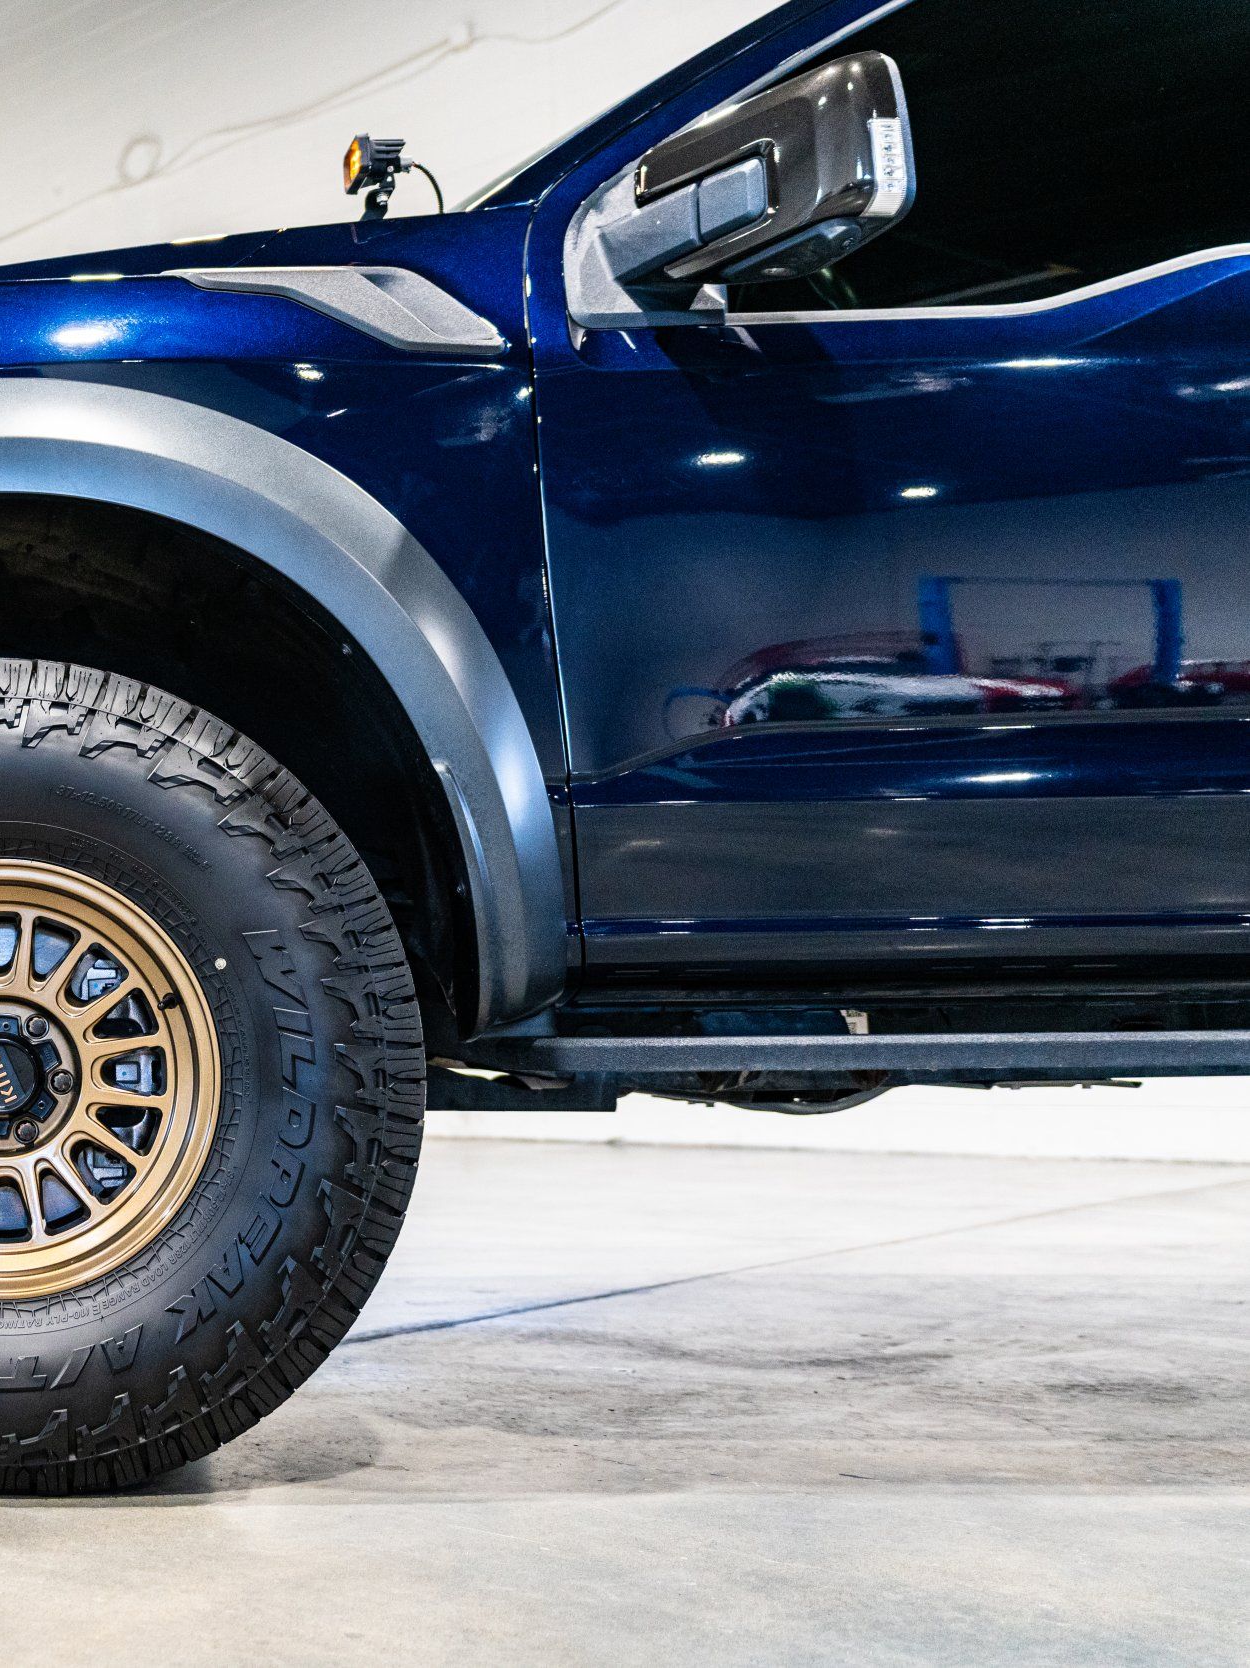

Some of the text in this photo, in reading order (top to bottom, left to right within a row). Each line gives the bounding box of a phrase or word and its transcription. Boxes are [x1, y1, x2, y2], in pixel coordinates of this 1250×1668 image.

[165, 930, 316, 1343] WILDPEAK
[141, 1265, 169, 1287] LOAD
[102, 1285, 141, 1310] RANGE
